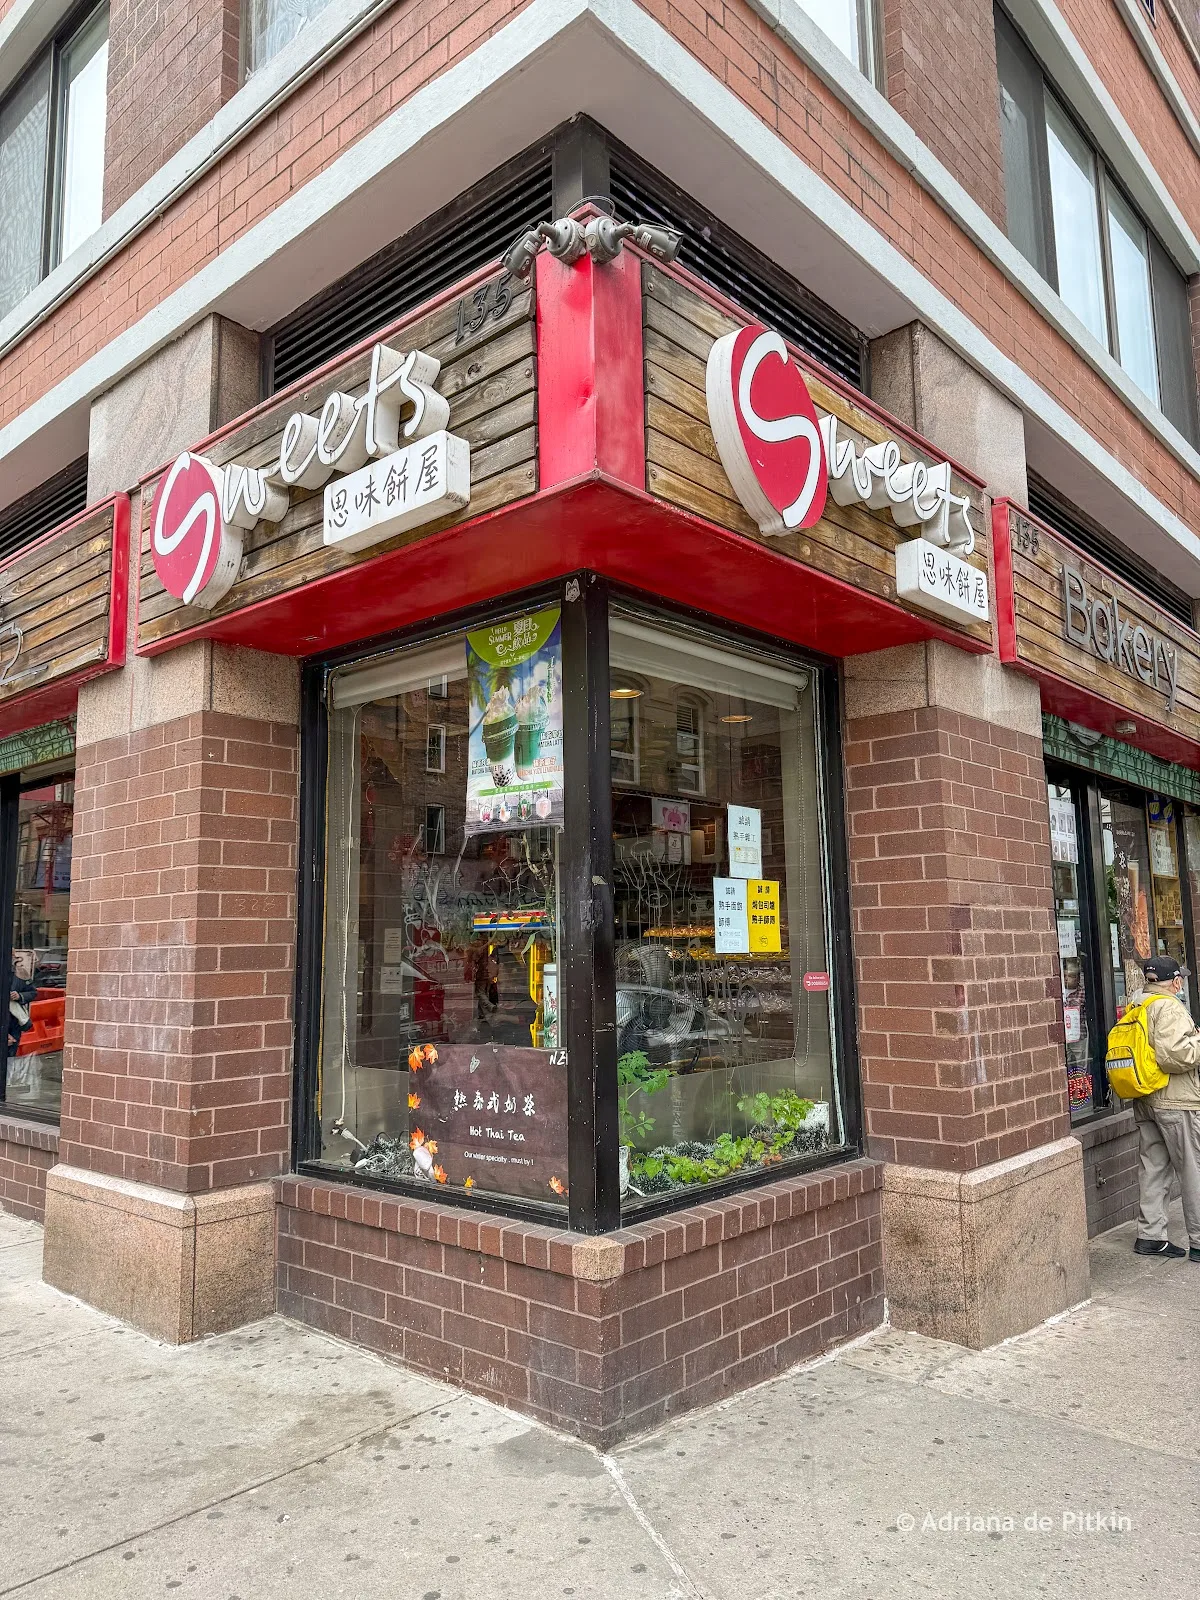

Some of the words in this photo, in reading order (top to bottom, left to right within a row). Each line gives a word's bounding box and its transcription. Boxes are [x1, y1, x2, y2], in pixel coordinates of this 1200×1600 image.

[455, 271, 514, 345] 135
[152, 342, 440, 605] Sweets
[739, 330, 975, 555] Sweets
[328, 444, 440, 530] 思味餅屋
[1015, 515, 1040, 555] 135
[922, 551, 986, 609] 思味餅屋
[488, 632, 512, 645] SUMMER
[1061, 563, 1179, 713] Bakery
[469, 1125, 482, 1138] Hot
[485, 1127, 505, 1140] Thai
[508, 1130, 526, 1142] Tea
